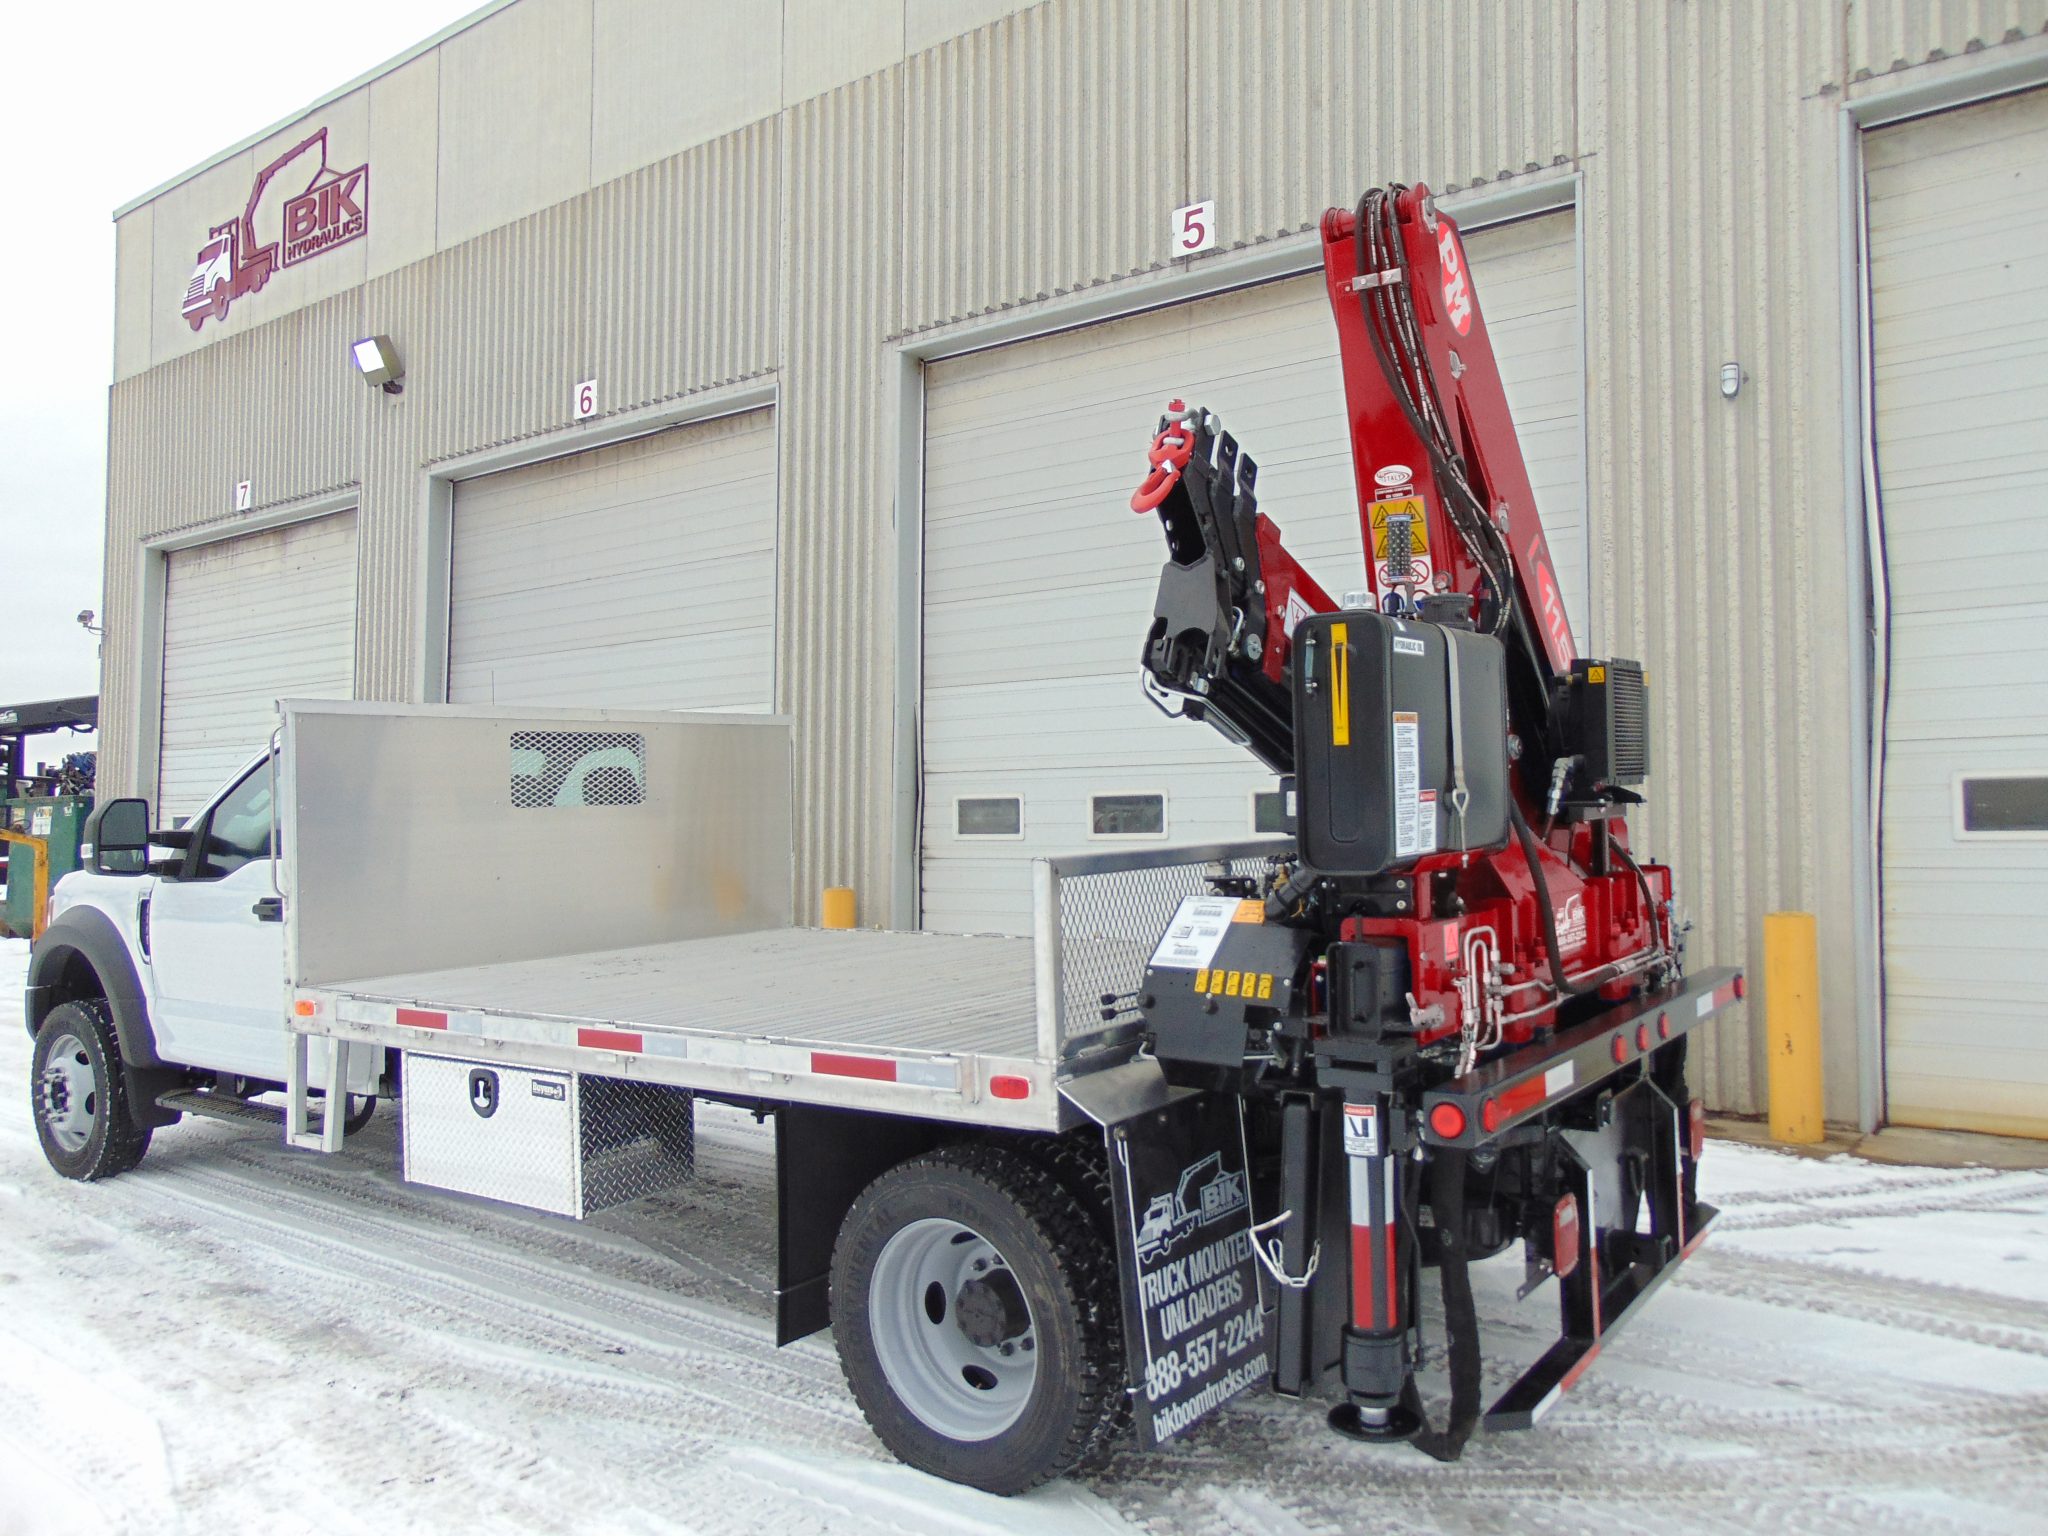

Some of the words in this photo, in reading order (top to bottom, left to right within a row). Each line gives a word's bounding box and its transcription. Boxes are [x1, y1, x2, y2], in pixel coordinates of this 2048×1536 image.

[287, 174, 362, 243] BIK
[287, 215, 363, 260] HYDRAULICS
[1182, 207, 1205, 249] 5
[1439, 231, 1471, 329] PM
[580, 385, 592, 414] 6
[240, 484, 248, 507] 7
[1203, 1175, 1244, 1211] BIK
[1141, 1258, 1190, 1310] TRUCK
[1188, 1228, 1253, 1286] MOUNTED
[1160, 1270, 1243, 1340] UNLOADERS
[1145, 1304, 1264, 1401] 888-557-2244
[1153, 1353, 1269, 1443] bikboomtrucks.com
